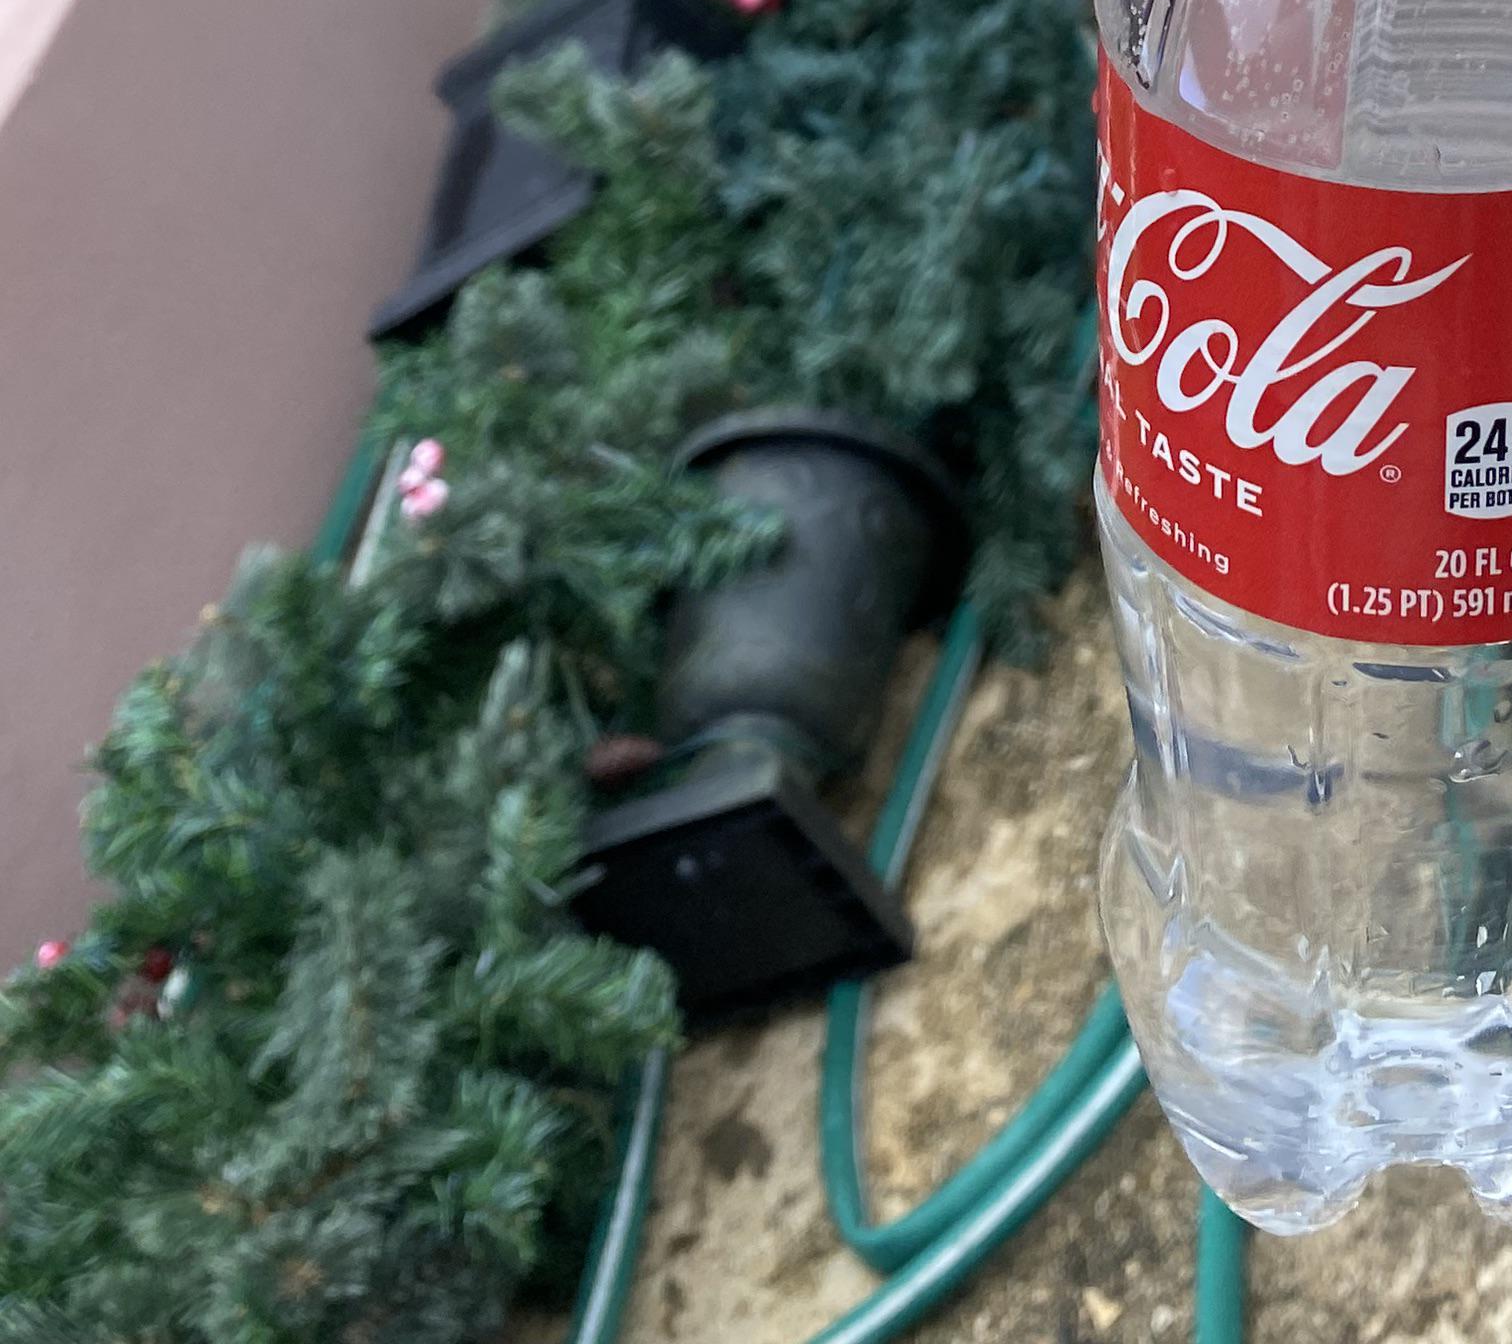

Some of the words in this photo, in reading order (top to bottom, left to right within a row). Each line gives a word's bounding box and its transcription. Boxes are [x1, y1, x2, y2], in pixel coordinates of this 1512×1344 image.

[1135, 409, 1263, 517] TASTE
[1115, 460, 1230, 576] Refreshing
[1449, 492, 1481, 510] PER
[1434, 549, 1468, 579] 20
[1475, 547, 1503, 577] FL
[1327, 582, 1393, 616] (1.25
[1400, 589, 1445, 623] PT)
[1452, 586, 1495, 618] 591
